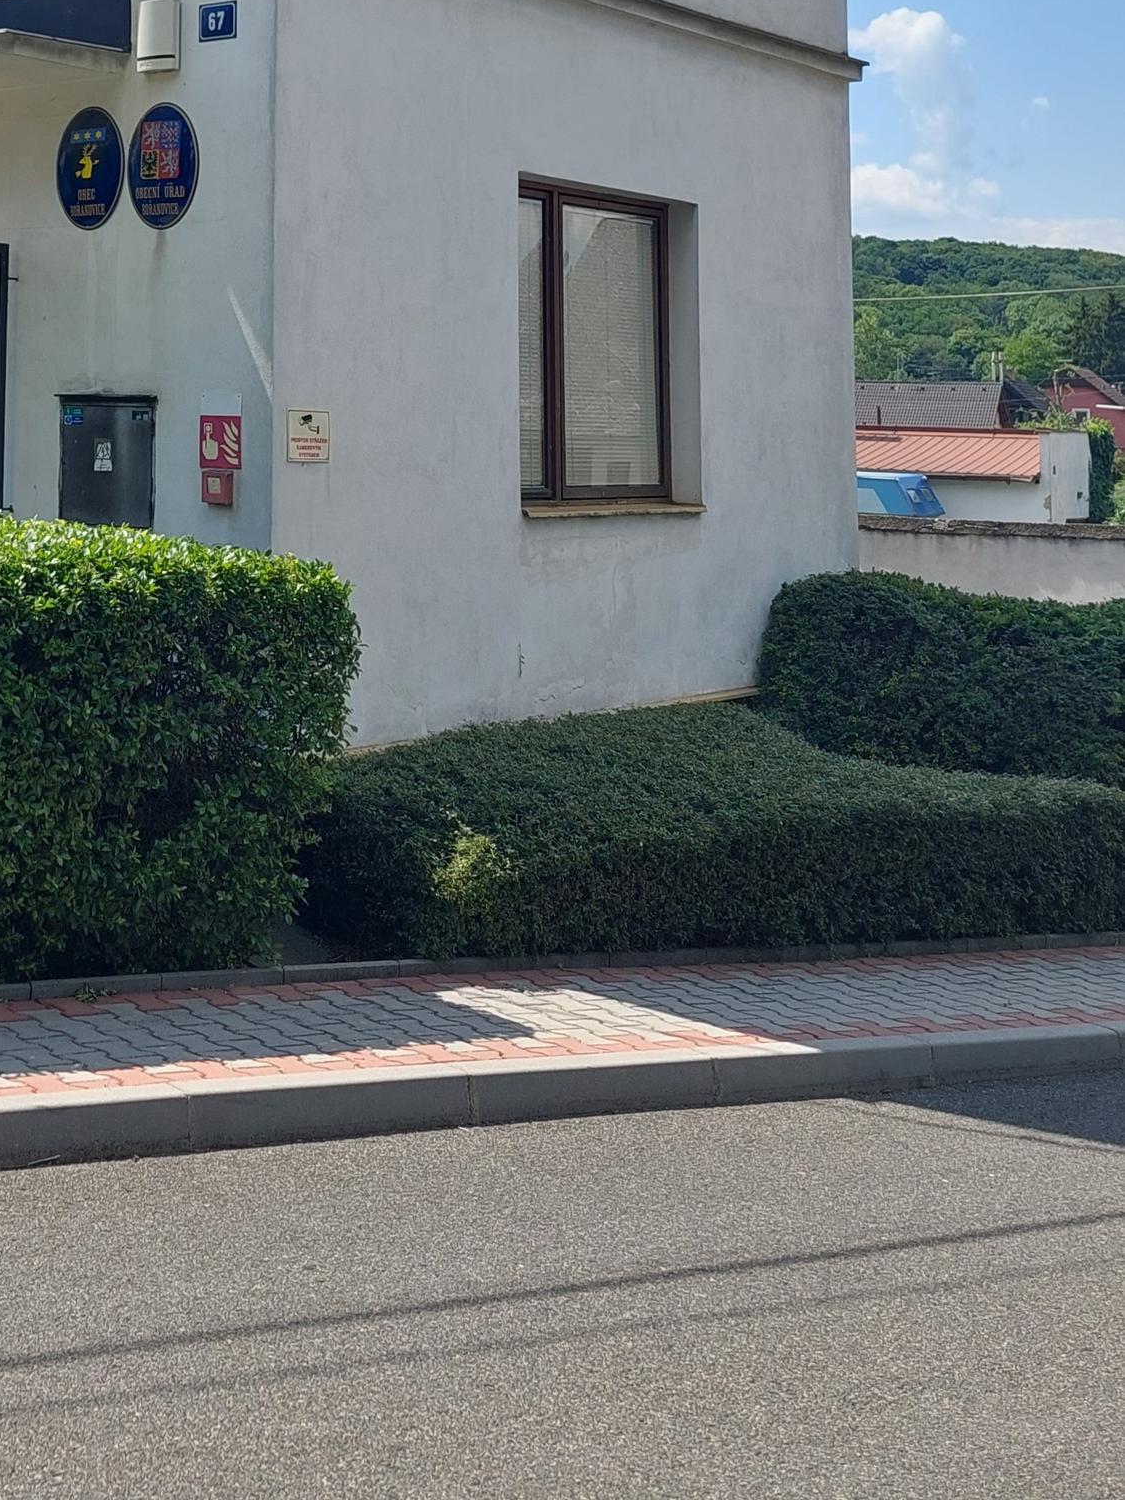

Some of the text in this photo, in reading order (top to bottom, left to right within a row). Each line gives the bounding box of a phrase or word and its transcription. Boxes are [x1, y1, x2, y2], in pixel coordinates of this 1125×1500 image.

[208, 11, 225, 32] 67
[77, 188, 96, 201] OBEC
[135, 183, 160, 199] OBECNÍ
